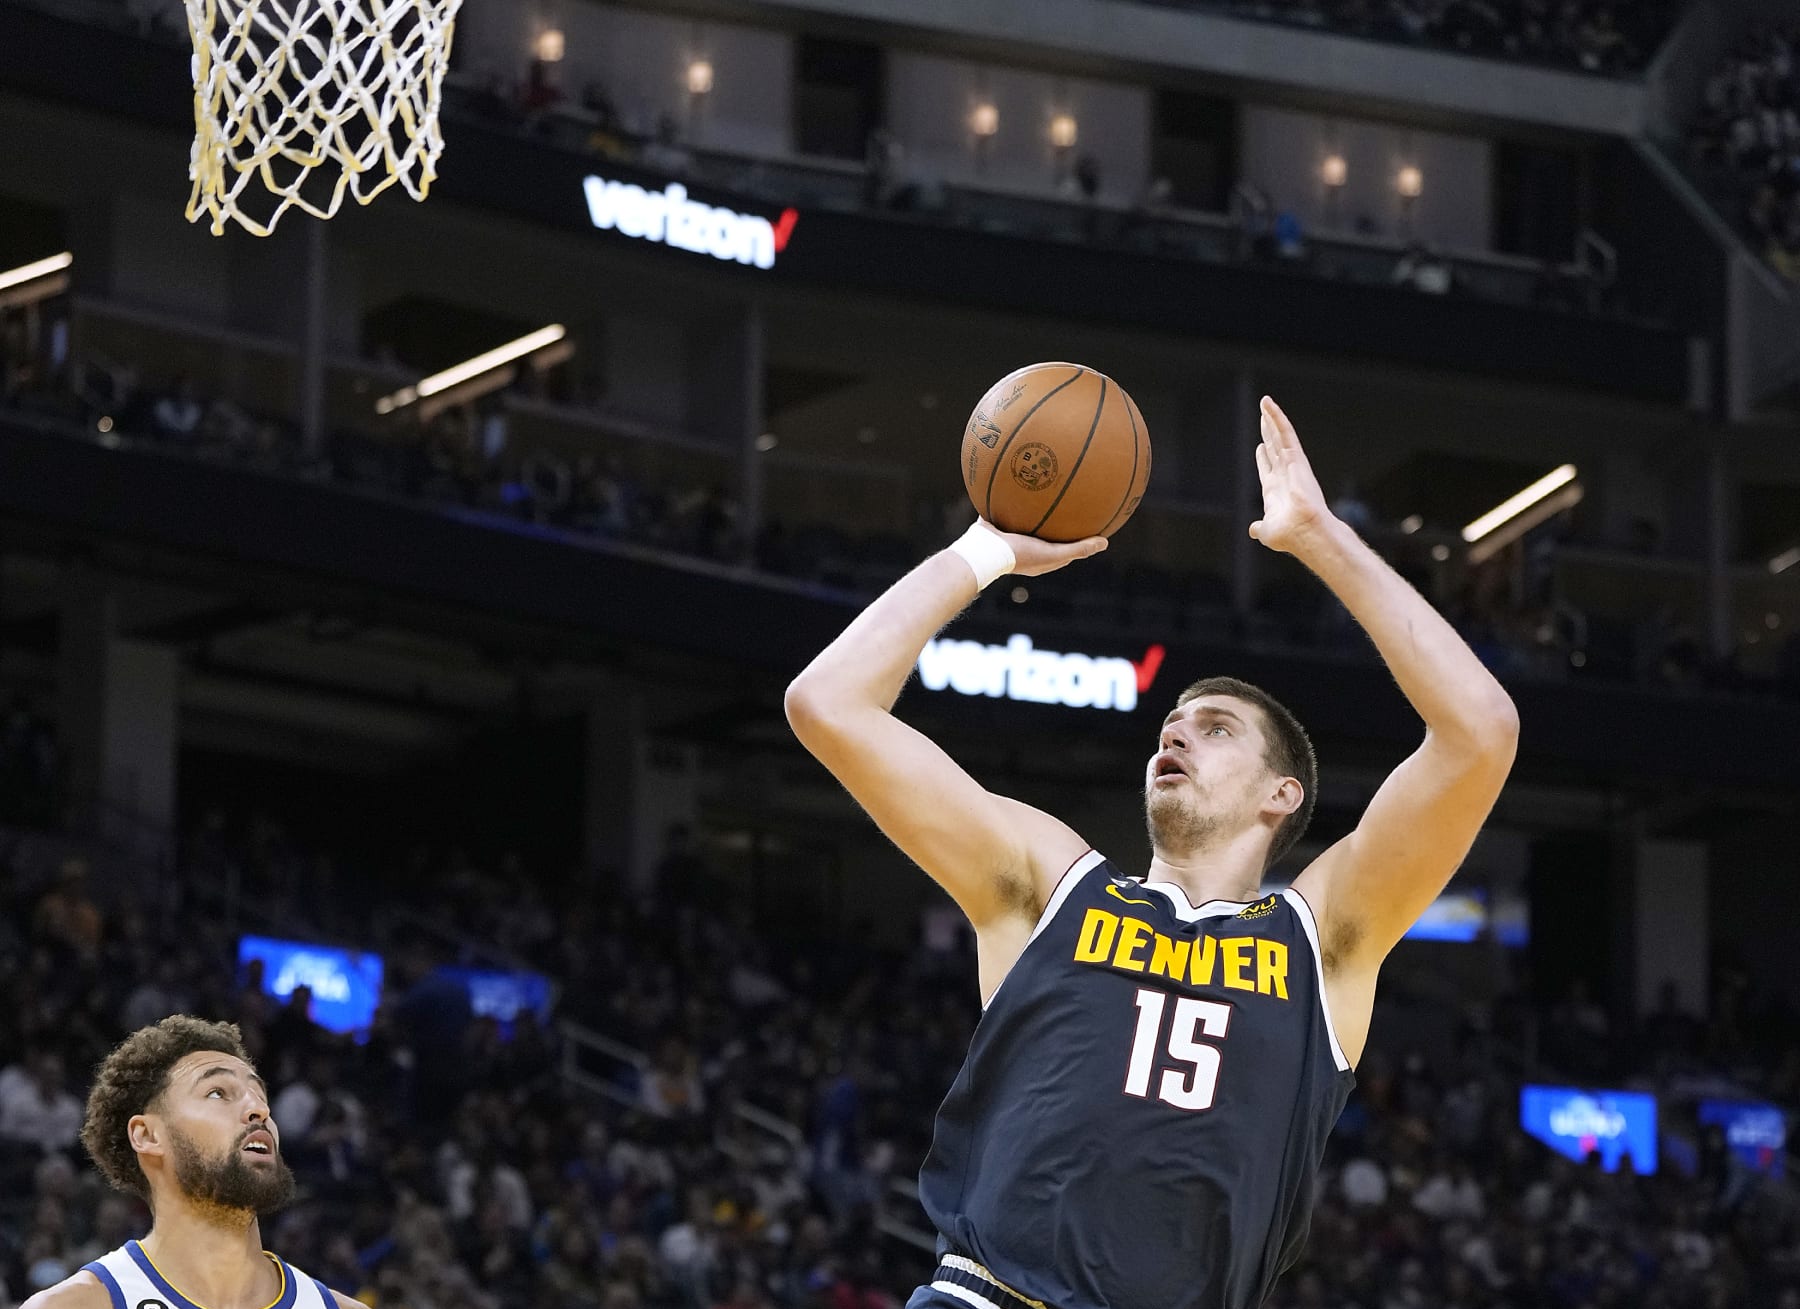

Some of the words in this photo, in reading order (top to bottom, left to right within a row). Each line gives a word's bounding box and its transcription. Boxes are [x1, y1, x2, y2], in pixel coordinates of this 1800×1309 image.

[583, 174, 776, 269] verizon
[917, 633, 1138, 712] verizon
[1073, 907, 1289, 1000] DENVER
[1122, 986, 1234, 1112] 15
